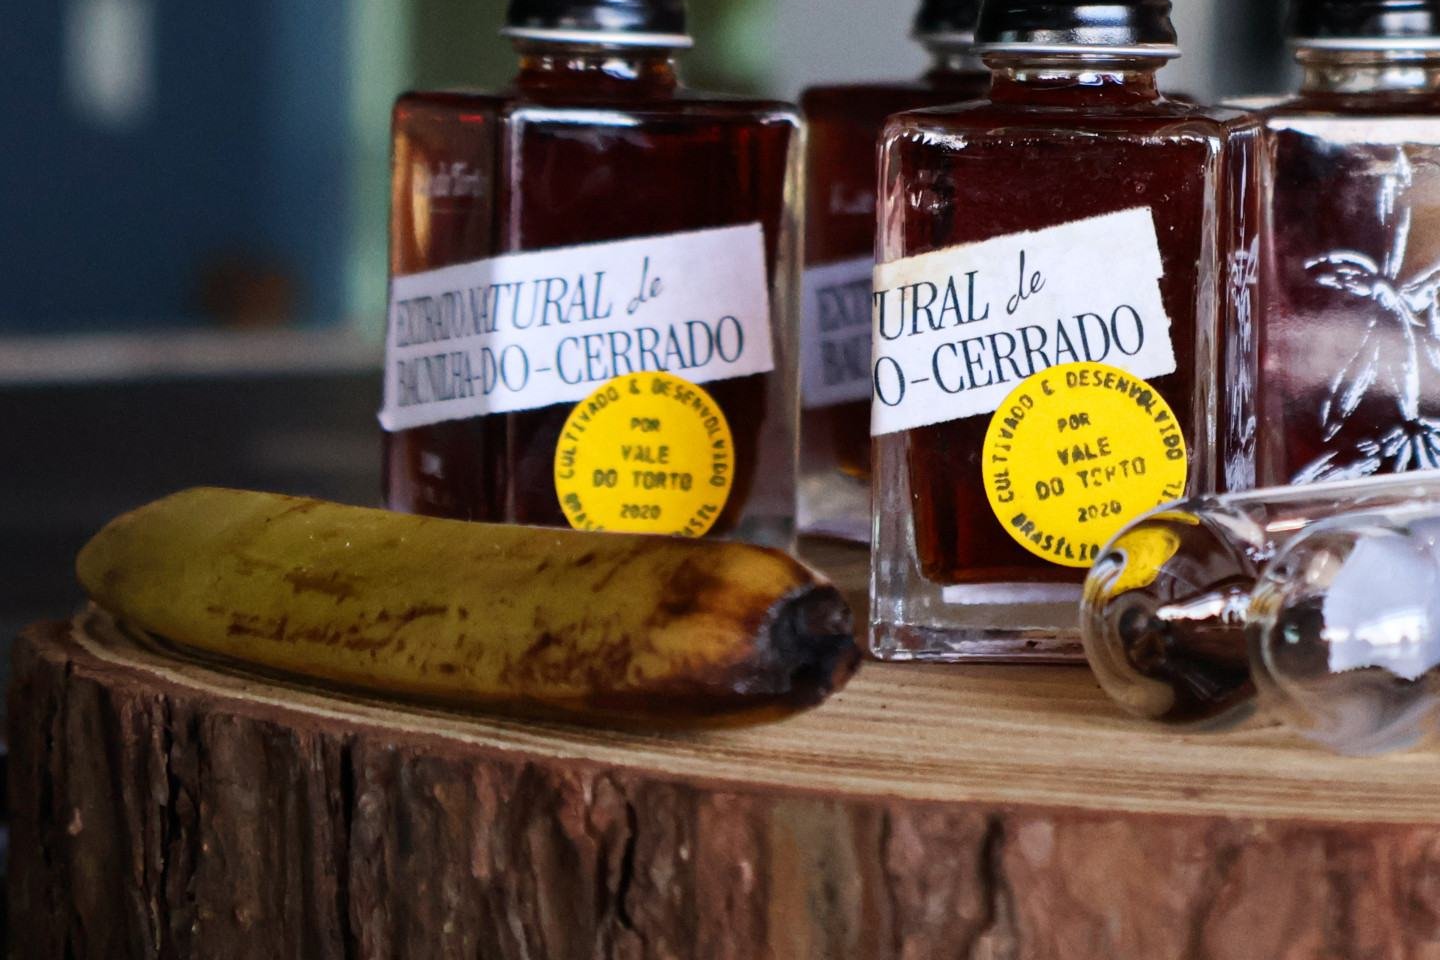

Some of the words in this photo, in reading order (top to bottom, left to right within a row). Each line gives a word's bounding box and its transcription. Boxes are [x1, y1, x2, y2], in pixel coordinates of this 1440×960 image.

[626, 256, 664, 316] de
[1006, 249, 1046, 316] de
[630, 416, 661, 433] POR
[1057, 412, 1092, 433] POR
[992, 393, 1034, 504] CULTIVADO
[1065, 369, 1184, 461] DESENVOLVIDO
[621, 445, 670, 464] VALE
[1056, 436, 1113, 466] VALE
[592, 468, 619, 489] DO
[632, 470, 693, 491] TORTO
[1035, 476, 1066, 501] DO
[619, 504, 662, 520] 2020
[1077, 499, 1123, 523] 2020
